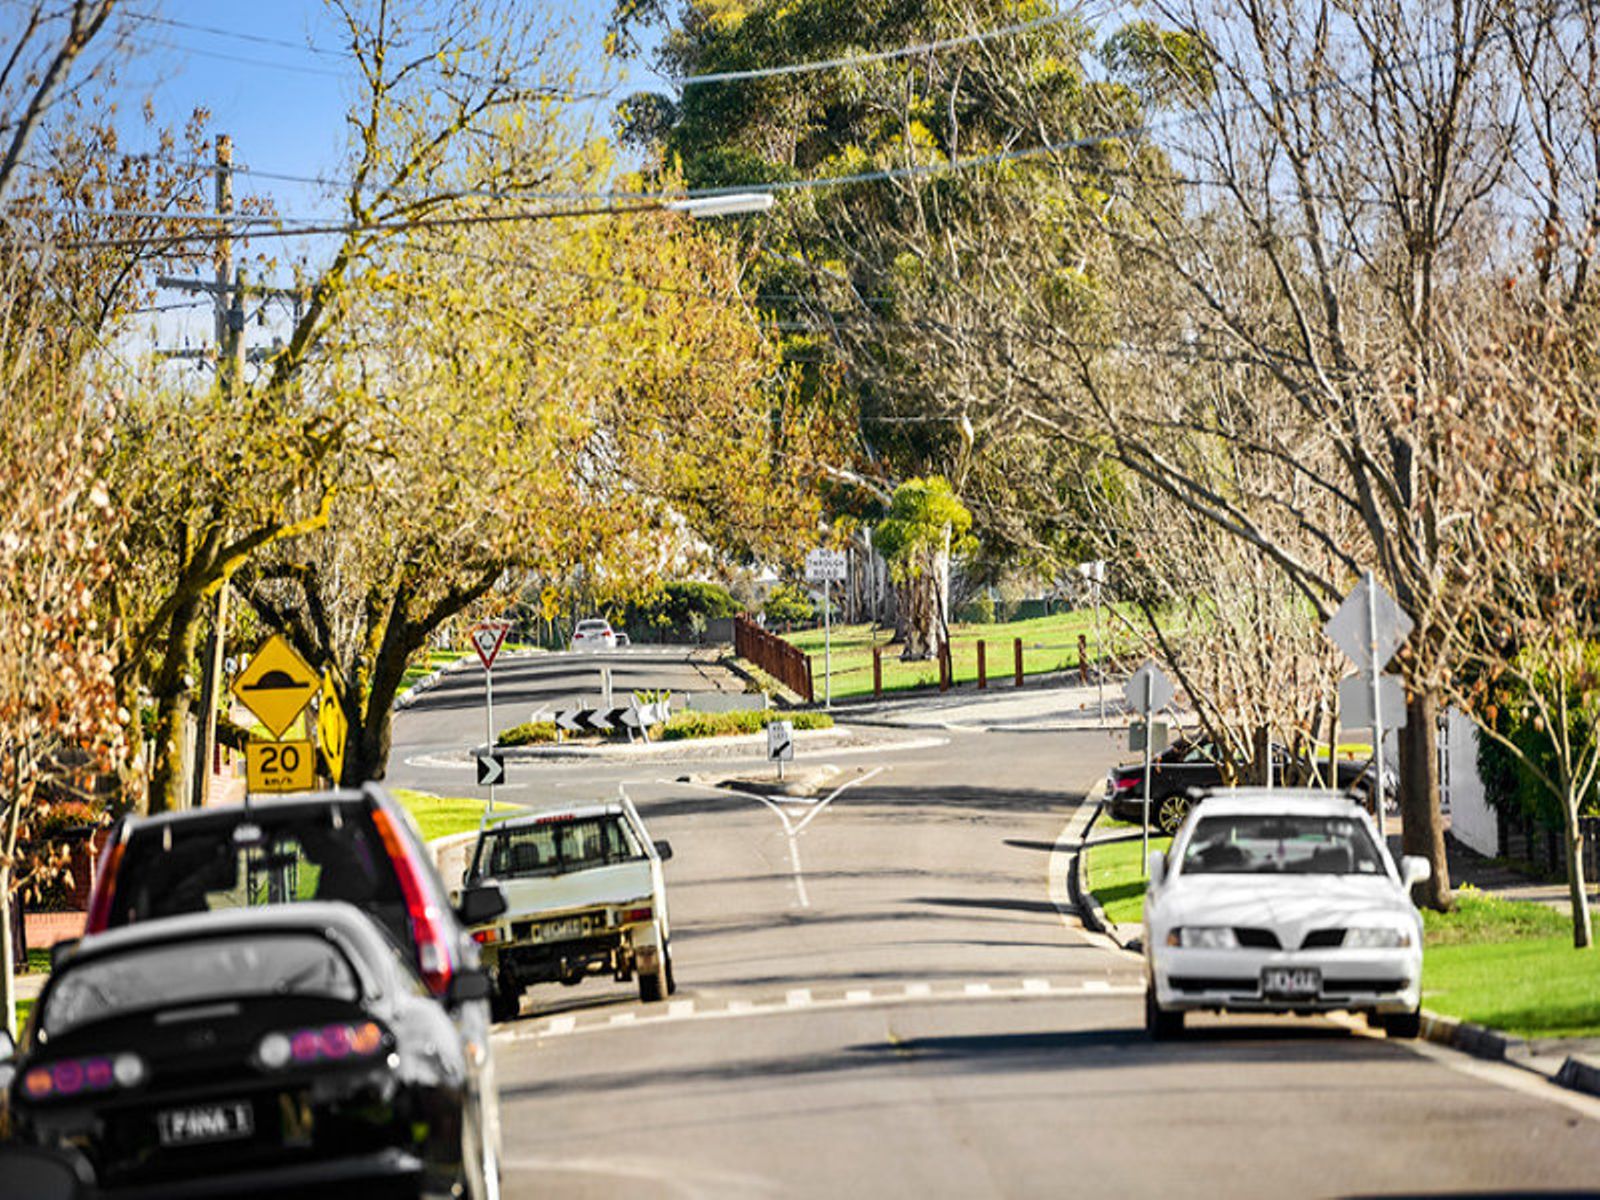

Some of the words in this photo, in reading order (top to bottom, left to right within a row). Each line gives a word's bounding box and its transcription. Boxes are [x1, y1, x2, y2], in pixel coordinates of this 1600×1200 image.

[809, 559, 844, 568] THROUGH
[813, 569, 839, 578] ROAD
[260, 745, 300, 773] 20
